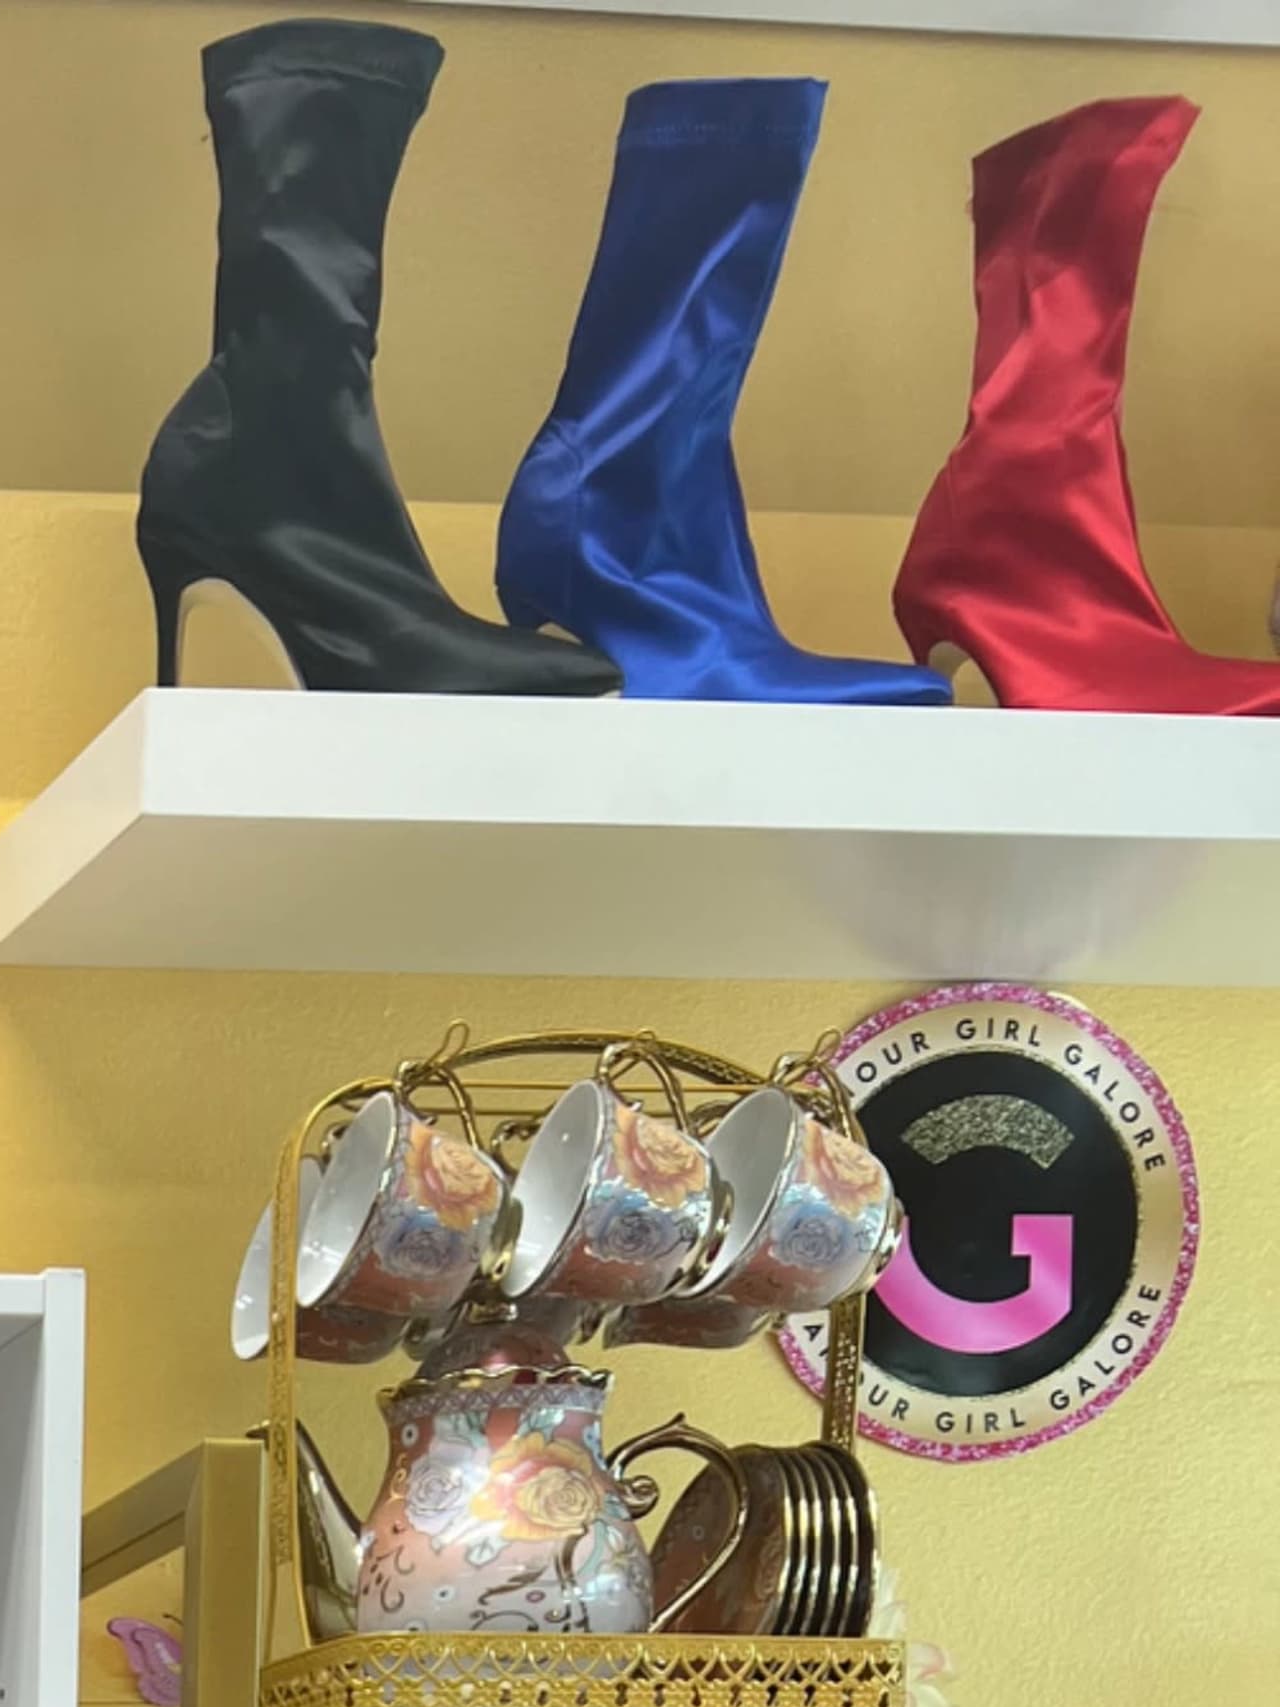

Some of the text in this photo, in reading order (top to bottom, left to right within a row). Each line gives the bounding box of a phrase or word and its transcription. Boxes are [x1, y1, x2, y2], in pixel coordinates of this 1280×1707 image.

[955, 1017, 1041, 1048] GIRL
[1063, 1043, 1167, 1173] GALORE
[935, 1407, 1027, 1434] GIRL
[1049, 1284, 1162, 1411] GALORE
